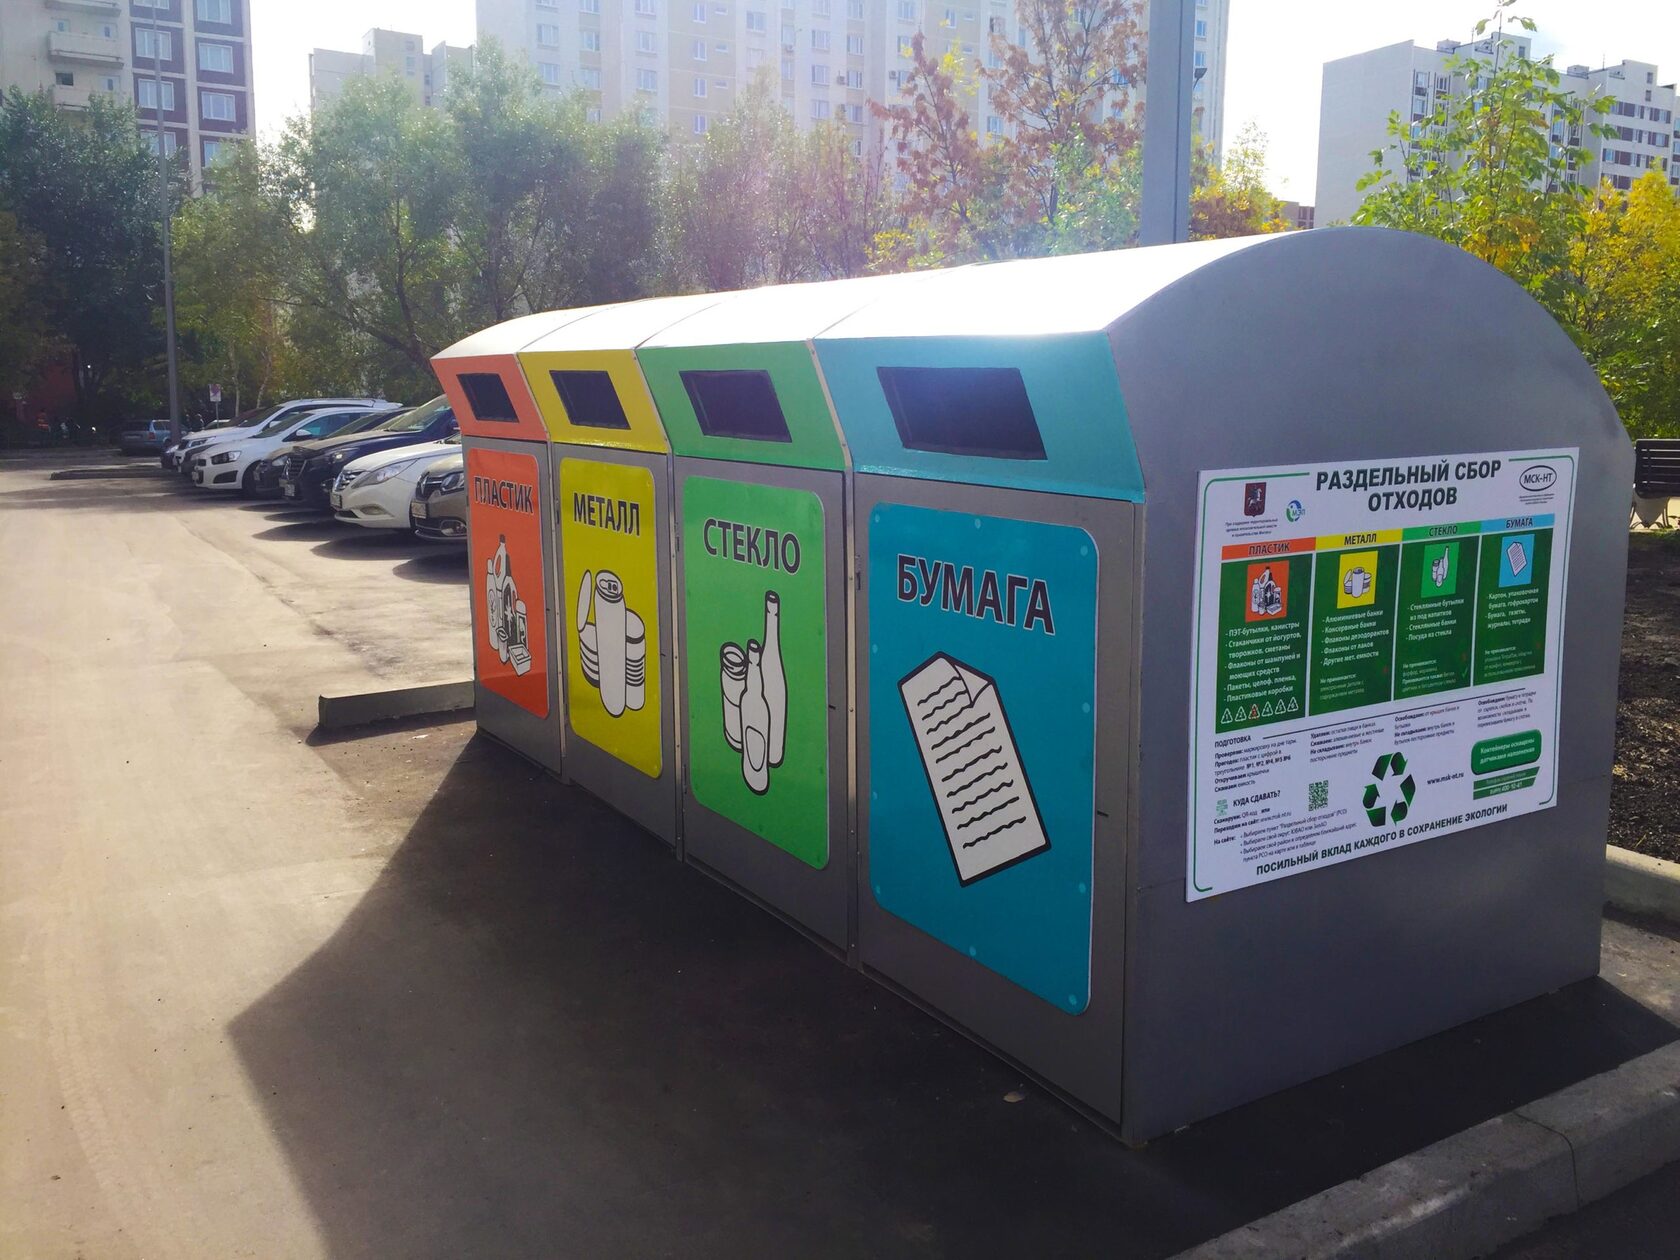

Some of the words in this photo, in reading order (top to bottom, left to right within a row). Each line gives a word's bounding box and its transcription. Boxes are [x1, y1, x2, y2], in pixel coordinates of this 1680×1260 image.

[1316, 459, 1449, 491] РАЗДЕЛЬНЫЙ
[1454, 459, 1502, 480] СБОР
[1523, 472, 1552, 483] МСК-НТ
[475, 476, 534, 514] ПЛАСТИК
[1367, 486, 1457, 511] ОТХОДОВ
[573, 492, 640, 537] МЕТАЛЛ
[1505, 517, 1533, 528] БУМАГА
[1428, 525, 1458, 536] СТЕКЛО
[1343, 533, 1376, 545] МЕТАЛЛ
[703, 517, 801, 575] СТЕКЛО
[1248, 542, 1290, 554] ПЛАСТИК
[897, 553, 1055, 635] БУМАГА
[1507, 588, 1539, 598] упаковочная
[1410, 601, 1441, 610] Стеклянные
[1441, 598, 1464, 607] бутылки
[1507, 597, 1538, 606] гофрокартон
[1325, 612, 1366, 622] Алюминиевые
[1270, 622, 1299, 630] канистры
[1324, 623, 1359, 633] Консервные
[1408, 621, 1440, 630] Стеклянные
[1228, 637, 1264, 647] Стаканчики
[1272, 632, 1301, 641] йогуртов,
[1324, 635, 1350, 643] Флаконы
[1350, 629, 1389, 640] дезодорантов
[1264, 644, 1290, 653] сметаны
[1323, 645, 1349, 654] Флаконы
[1227, 660, 1256, 669] Флаконы
[1264, 652, 1295, 663] шампуней
[1323, 656, 1343, 665] Другие
[1229, 671, 1255, 679] моющих
[1256, 666, 1280, 676] средств
[1226, 690, 1267, 701] Пластиковые
[1267, 685, 1293, 695] коробки
[1214, 735, 1251, 747] ПОДГОТОВКА
[1480, 743, 1510, 753] Контейнеры
[1510, 738, 1535, 747] оснащены
[1479, 753, 1506, 764] датчиками
[1426, 772, 1464, 784] www.msk-nt.ru
[1232, 796, 1249, 806] КУДА
[1249, 789, 1280, 802] СДАВАТЬ?
[1256, 849, 1319, 875] ПОСИЛЬНЫЙ
[1321, 842, 1351, 858] ВКЛАД
[1353, 831, 1397, 850] КАЖДОГО
[1398, 829, 1405, 838] В
[1406, 814, 1463, 836] СОХРАНЕНИЕ
[1464, 803, 1507, 821] ЭКОЛОГИИ
